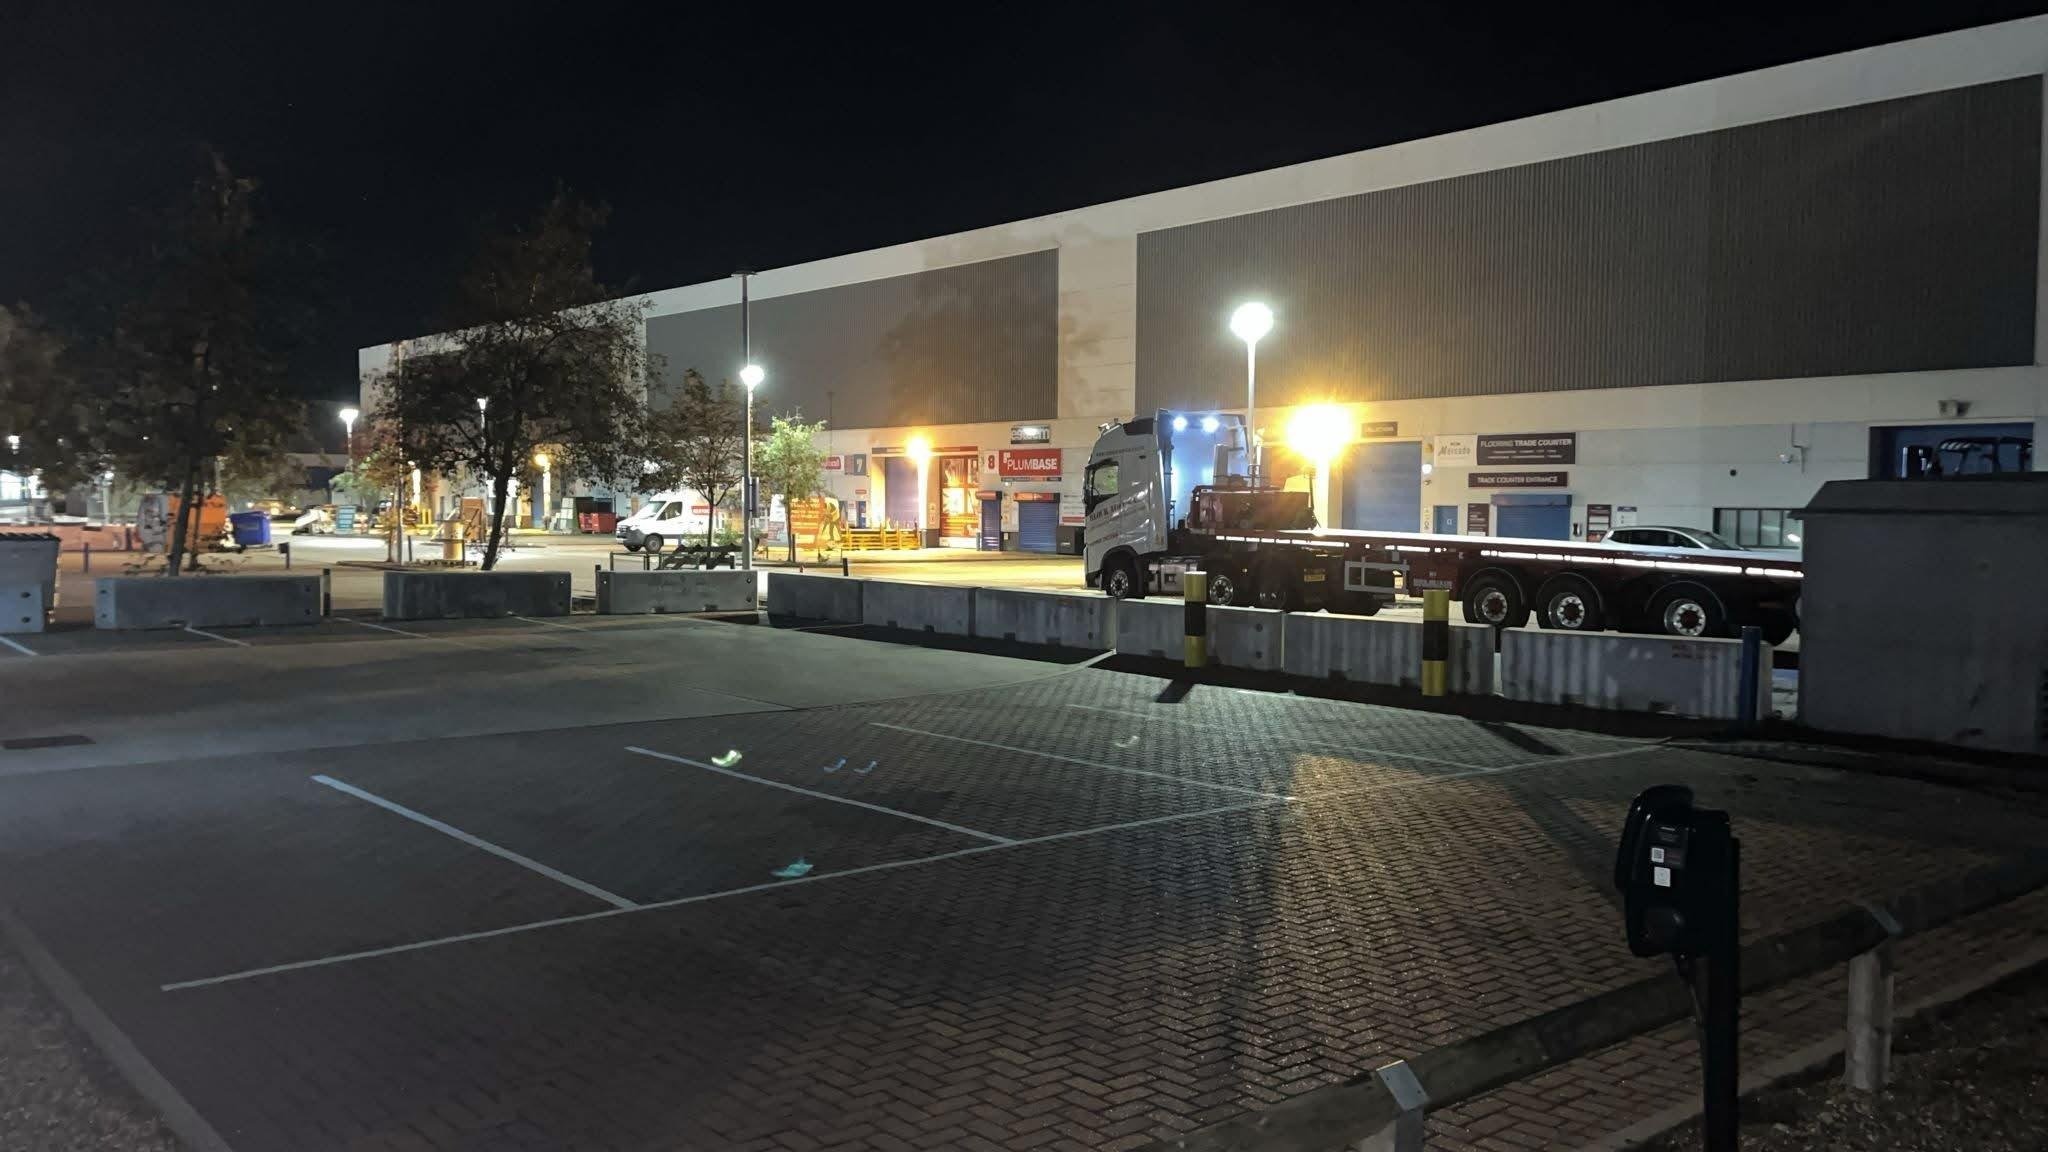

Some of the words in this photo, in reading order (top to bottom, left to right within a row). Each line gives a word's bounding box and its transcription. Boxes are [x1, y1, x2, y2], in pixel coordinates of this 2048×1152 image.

[1515, 439, 1537, 447] TRADE
[1538, 438, 1572, 446] COUNTER
[856, 458, 863, 472] 7
[988, 455, 995, 469] 8
[1007, 458, 1057, 471] PLUMBASE
